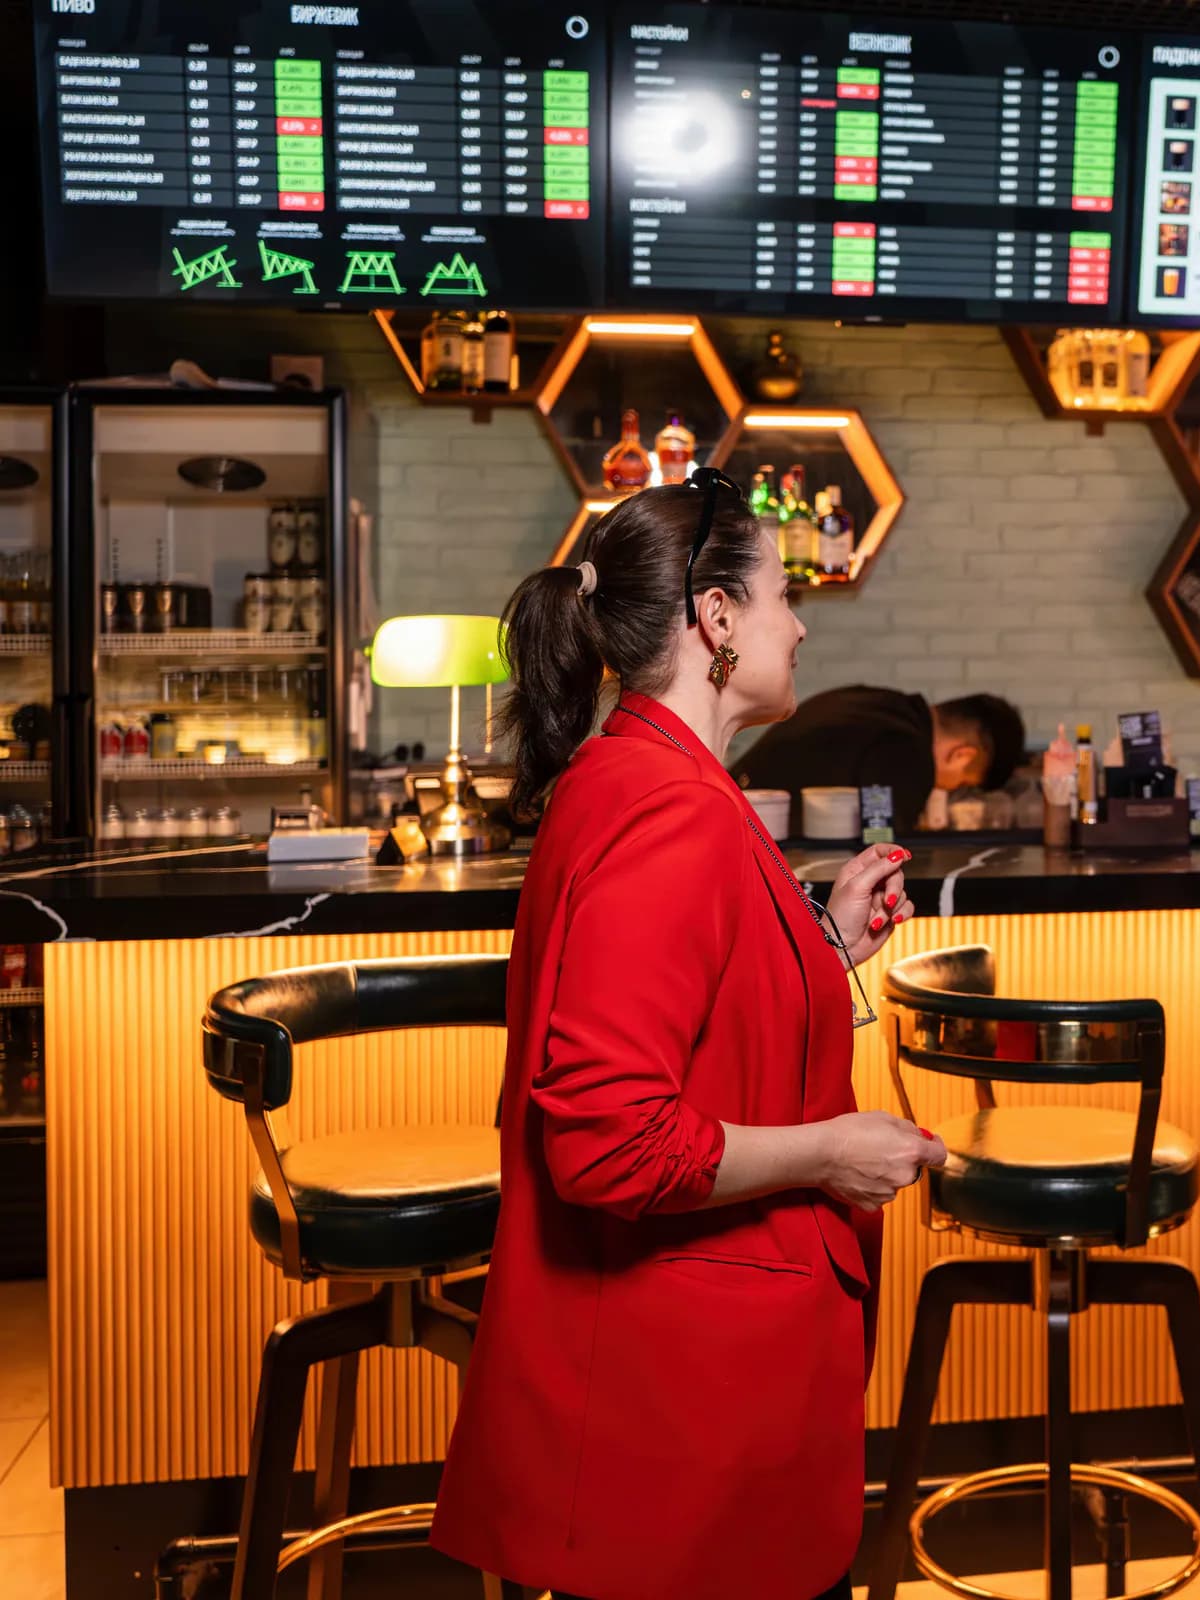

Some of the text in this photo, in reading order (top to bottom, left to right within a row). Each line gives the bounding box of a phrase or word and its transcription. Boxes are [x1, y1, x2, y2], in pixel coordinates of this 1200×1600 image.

[52, 0, 95, 13] ПИВО
[291, 4, 359, 26] БИРЖЕВИК
[631, 24, 689, 41] НАСТОЙКИ
